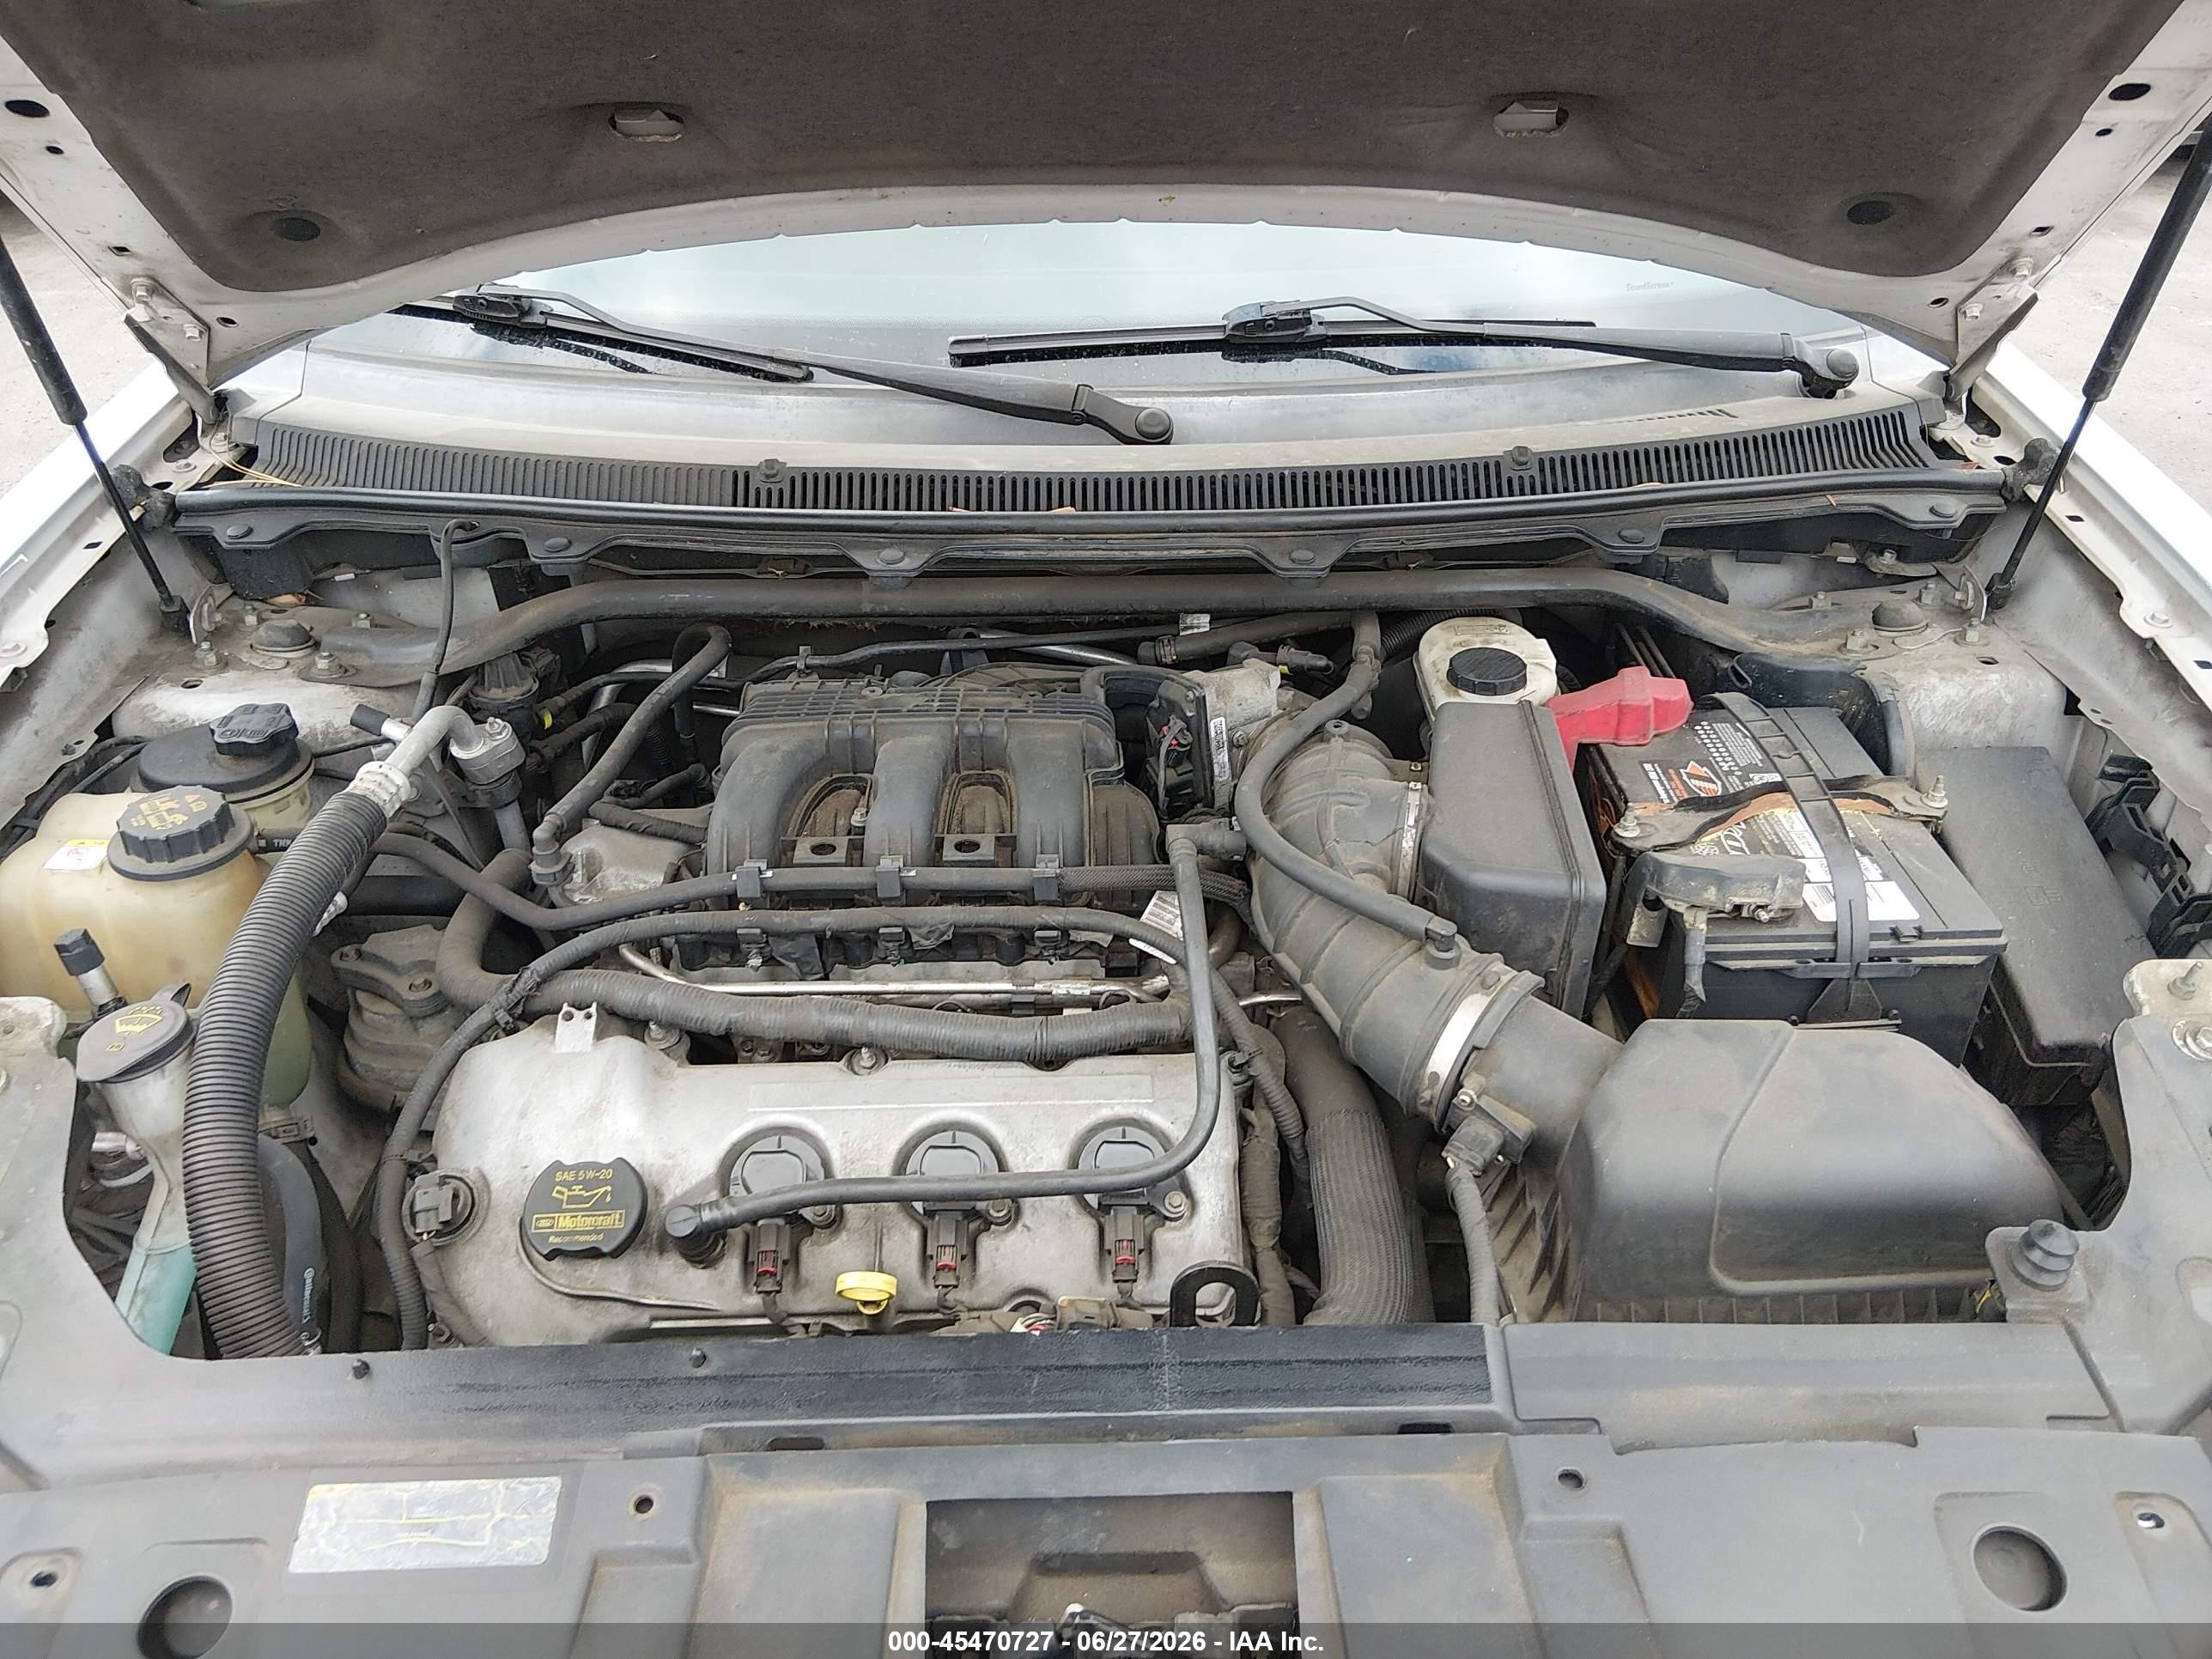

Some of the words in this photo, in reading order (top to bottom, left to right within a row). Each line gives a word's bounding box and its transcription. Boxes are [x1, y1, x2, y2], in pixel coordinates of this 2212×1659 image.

[555, 1170, 576, 1182] SAE
[578, 1168, 613, 1181] 5W-20
[558, 1212, 622, 1230] Motorcraft
